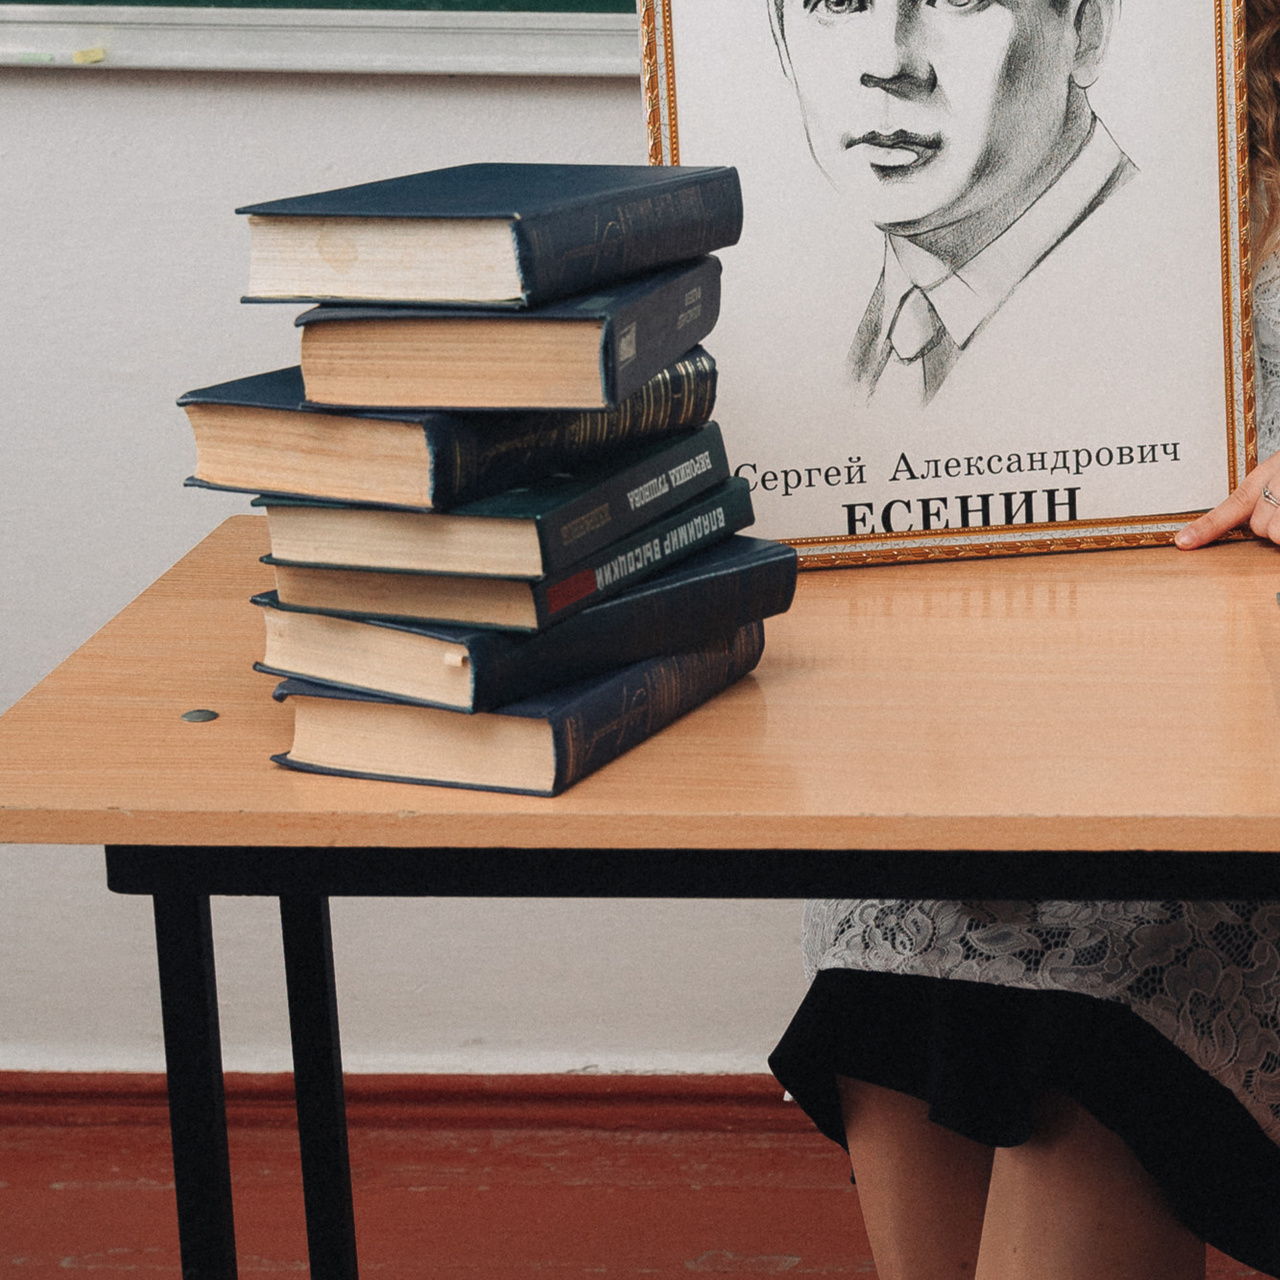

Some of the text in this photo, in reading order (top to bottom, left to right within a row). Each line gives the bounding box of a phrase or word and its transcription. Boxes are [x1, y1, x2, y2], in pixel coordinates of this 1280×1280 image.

[669, 451, 712, 488] ВЕРОНИКА
[734, 440, 1182, 497] Сергей Александрович
[664, 507, 726, 554] ВЛАДИМИР
[842, 486, 1081, 536] ЕСЕНИН
[594, 538, 661, 591] ВЫСОЦКИЙ
